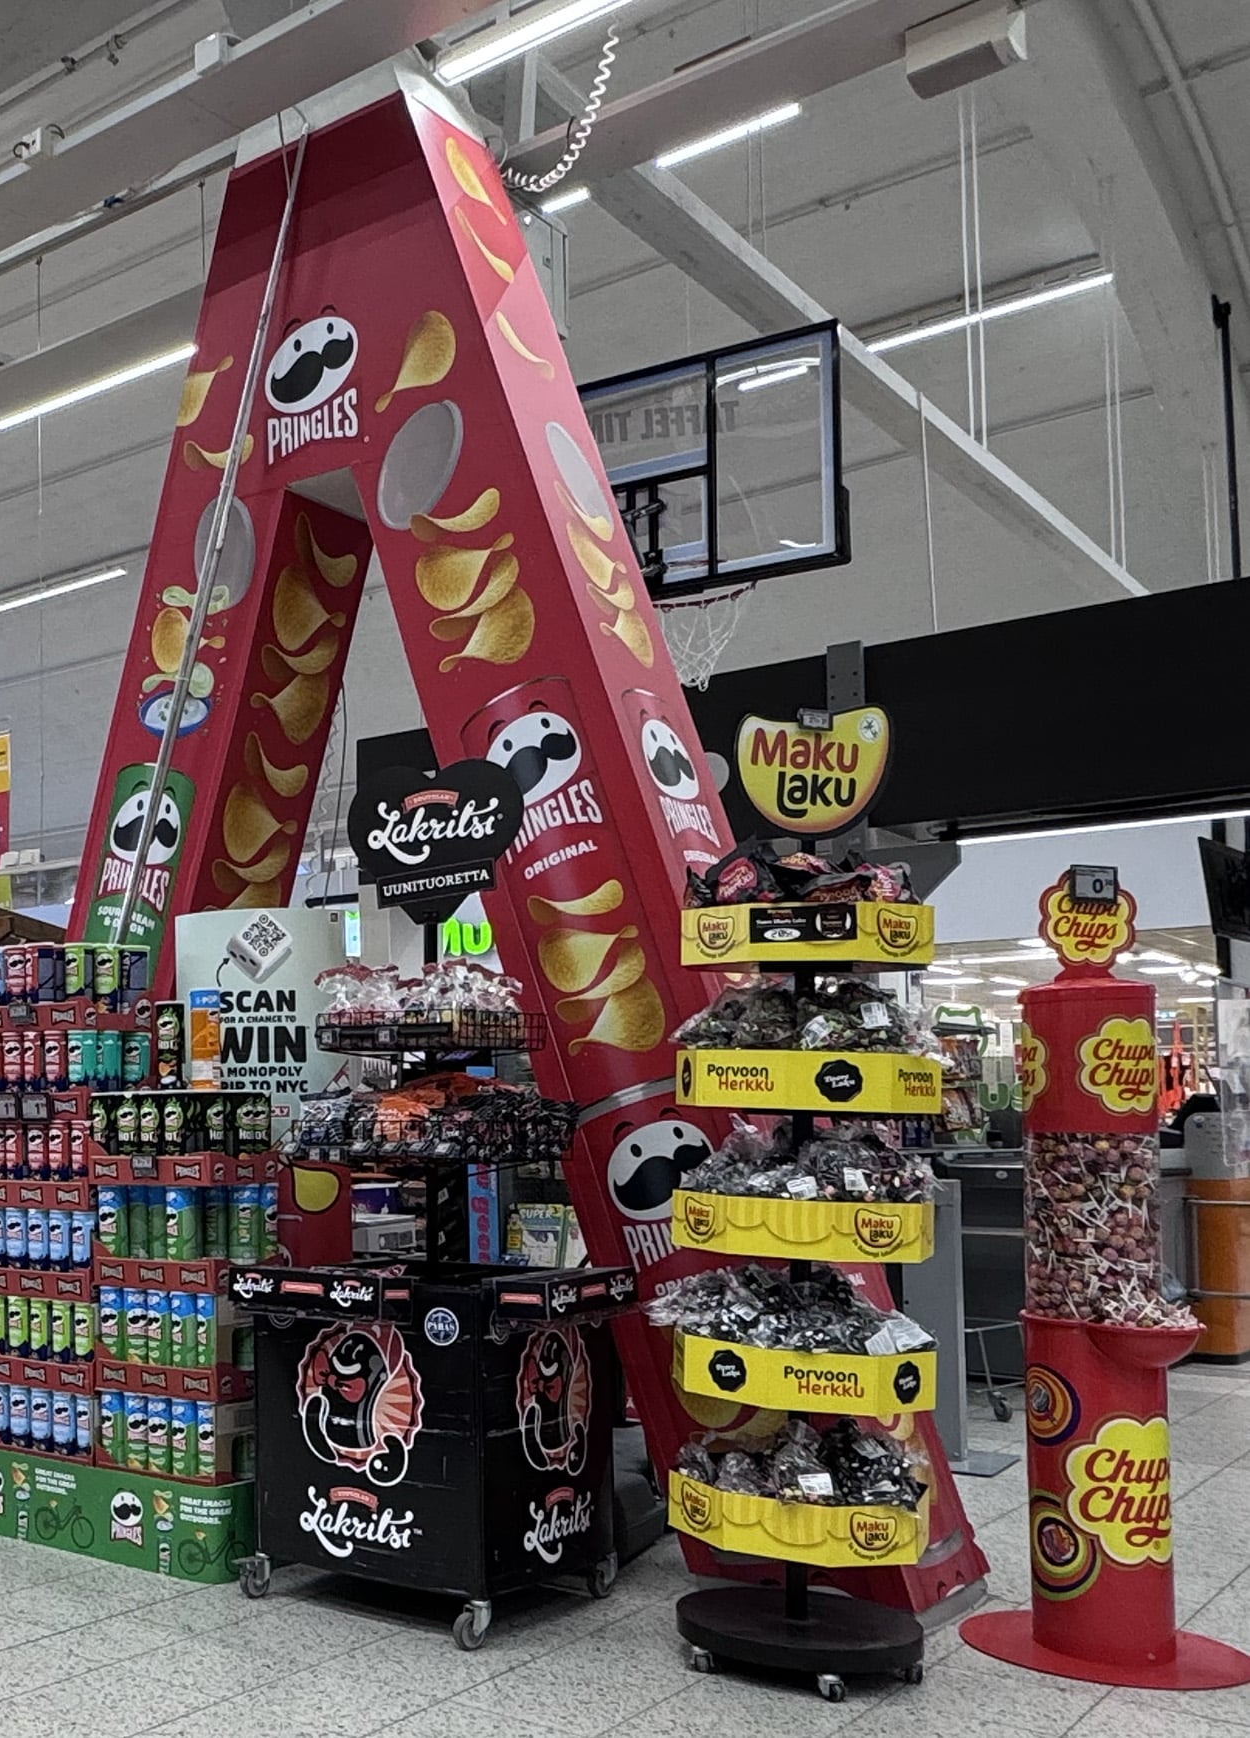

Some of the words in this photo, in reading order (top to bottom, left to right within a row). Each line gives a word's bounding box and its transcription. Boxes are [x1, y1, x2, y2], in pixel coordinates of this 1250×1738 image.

[267, 388, 359, 465] PRINGLES
[751, 727, 859, 773] Maku
[777, 771, 857, 819] Laku
[367, 797, 499, 866] Lakritsi
[658, 795, 721, 849] PRINGLES
[523, 838, 599, 880] ORIGINAL
[97, 857, 171, 912] PRINLES
[382, 868, 491, 898] UUNITUORETTA
[701, 921, 728, 933] Maku
[882, 918, 911, 930] Maku
[1053, 915, 1119, 952] Chups
[220, 990, 296, 1013] SCAN
[246, 1015, 283, 1023] CHANCE
[284, 1015, 297, 1023] TO
[221, 1026, 307, 1064] WIN
[227, 1066, 303, 1078] MONOPOLY
[706, 1063, 769, 1081] Porvoon
[898, 1069, 933, 1086] Porvoon
[276, 1080, 309, 1093] NYC
[718, 1077, 775, 1092] Herkku
[904, 1082, 936, 1097] Herkku
[861, 1217, 894, 1229] Maku
[784, 1365, 858, 1385] Porvoon
[798, 1381, 865, 1399] Herkku
[299, 1485, 415, 1559] Lakritsi
[523, 1490, 592, 1564] Lakritsi
[856, 1521, 889, 1533] Maku
